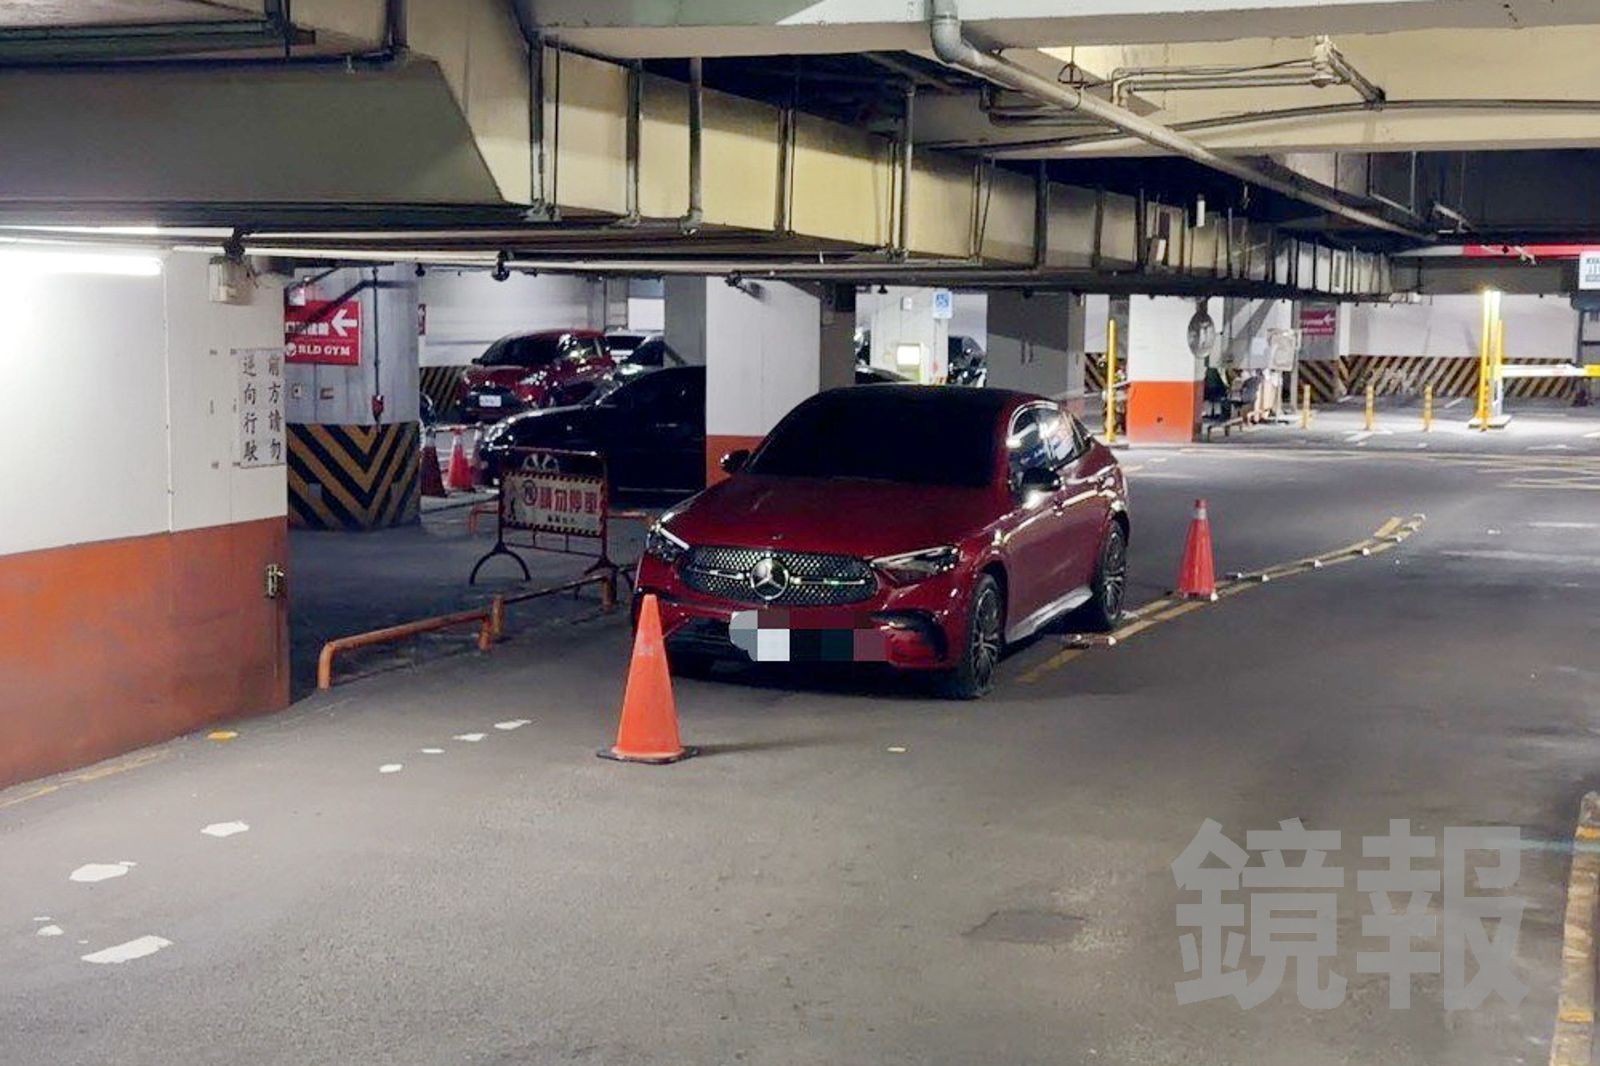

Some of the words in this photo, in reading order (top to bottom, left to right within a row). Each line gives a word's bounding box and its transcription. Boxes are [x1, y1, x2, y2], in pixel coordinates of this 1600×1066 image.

[324, 345, 350, 356] GYM
[242, 354, 258, 463] 逆向行駛
[267, 353, 282, 461] 前方請勿
